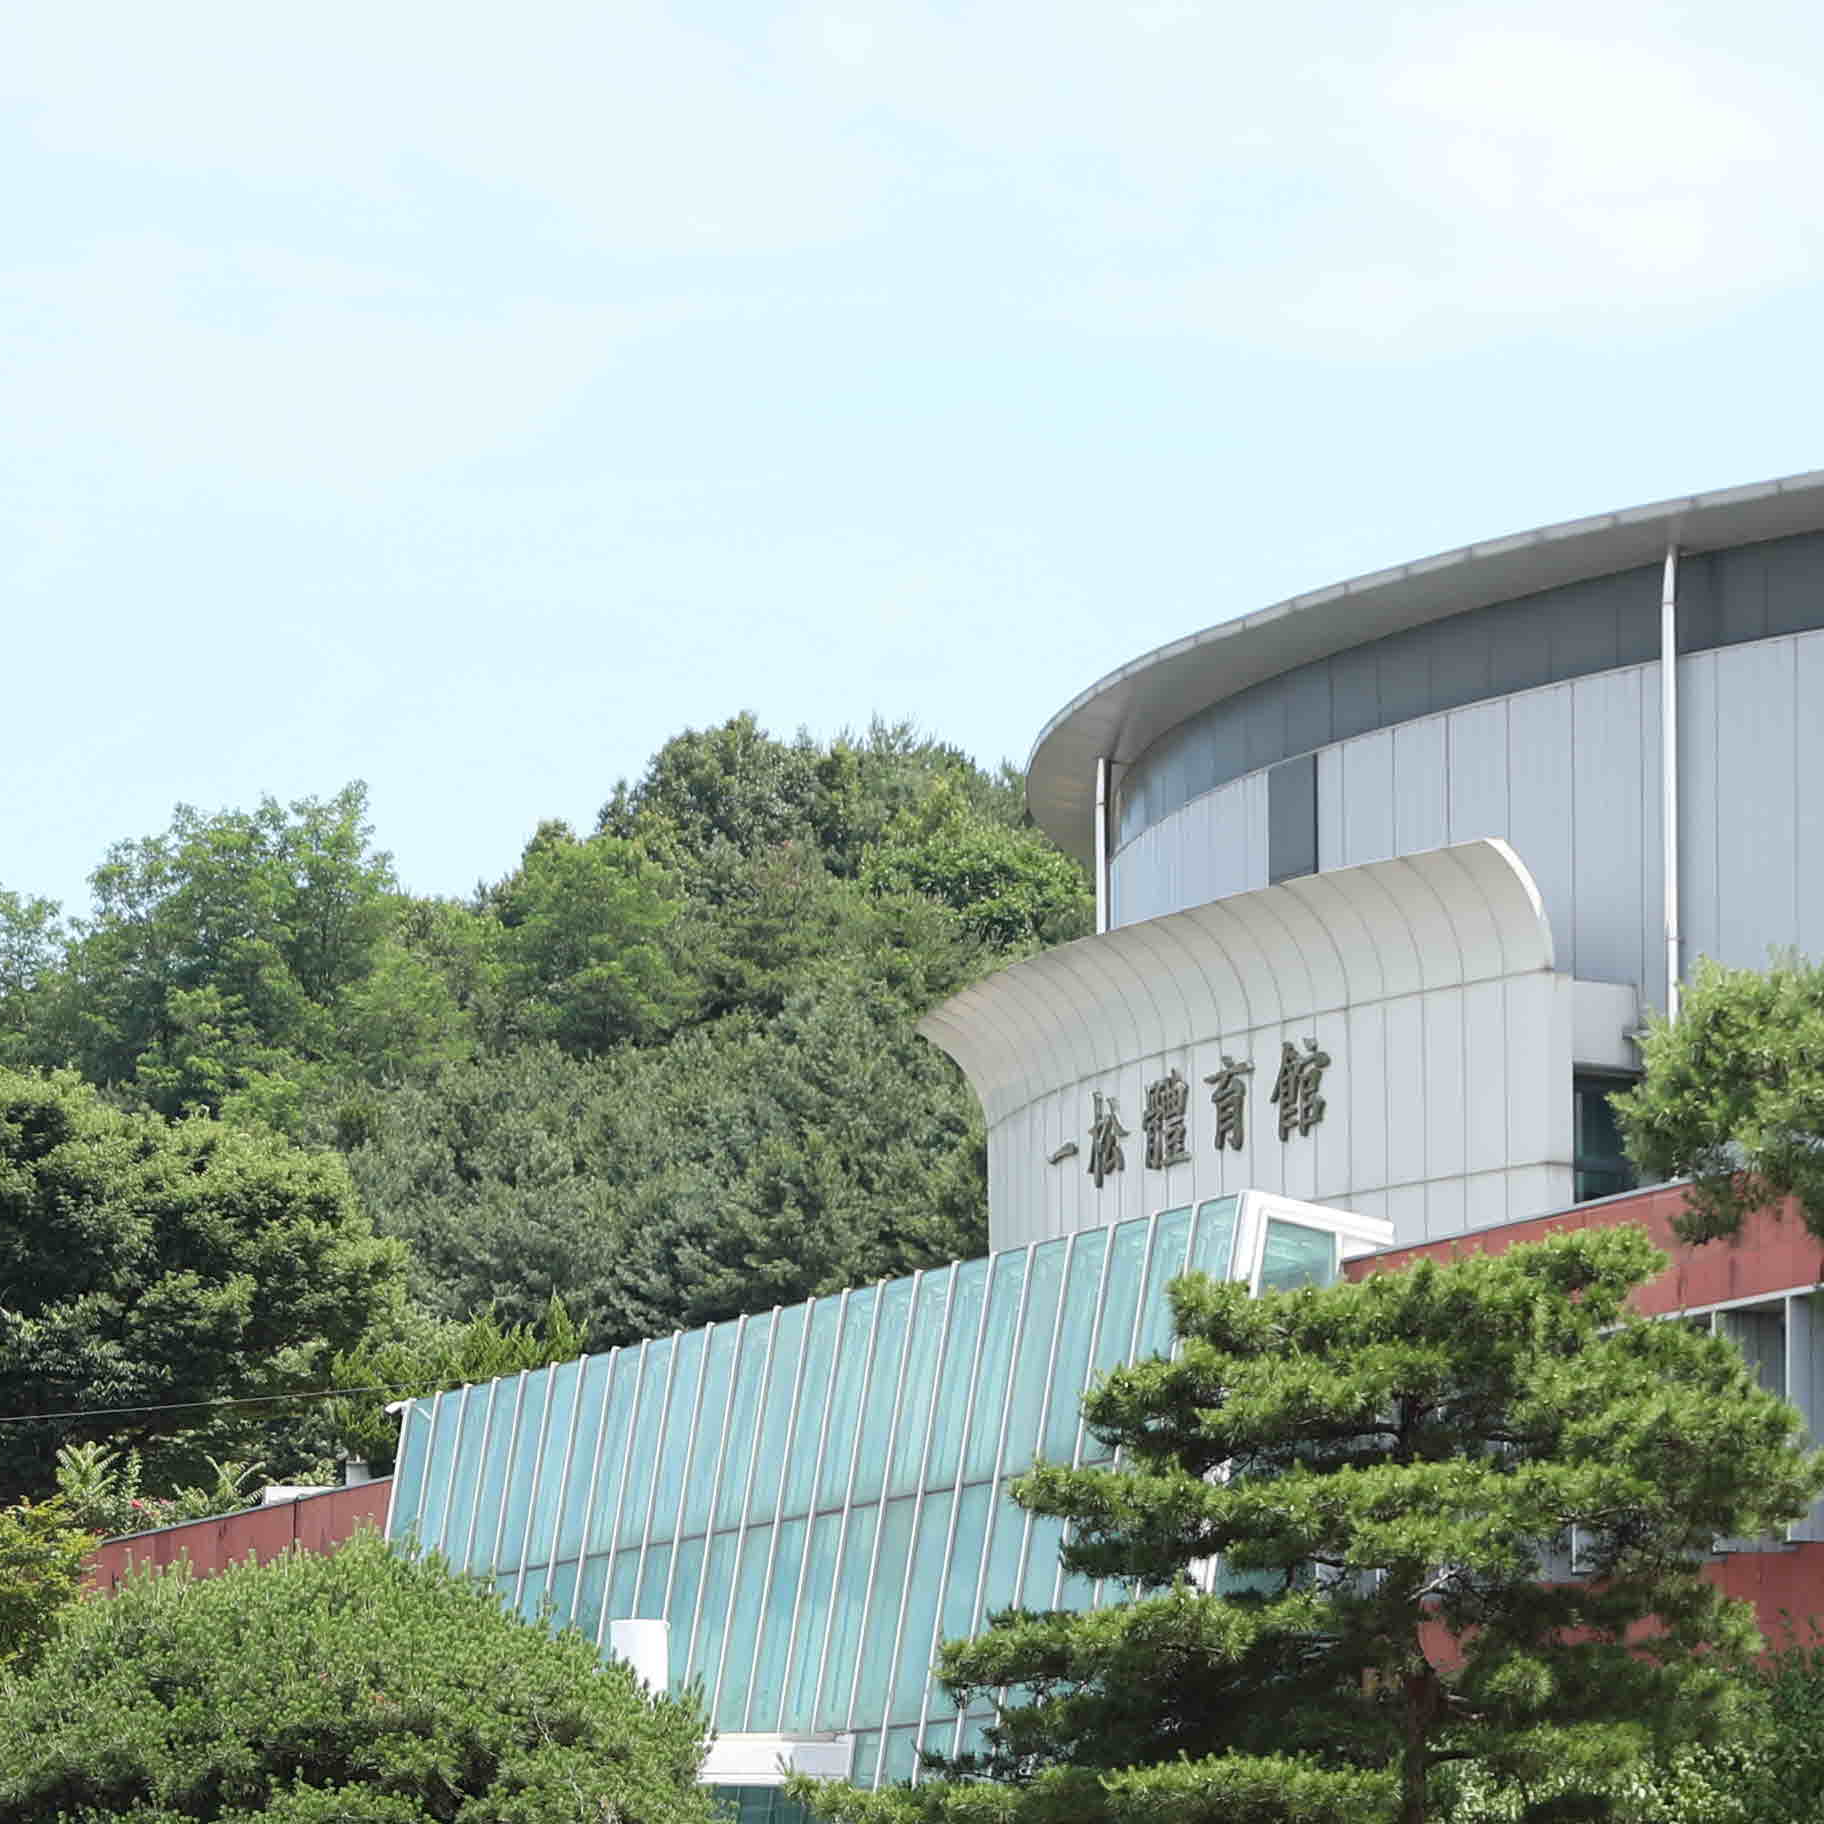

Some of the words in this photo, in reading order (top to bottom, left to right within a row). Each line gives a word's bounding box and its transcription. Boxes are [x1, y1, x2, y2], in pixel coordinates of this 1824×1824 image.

[1046, 1036, 1332, 1189] 一松體育館
